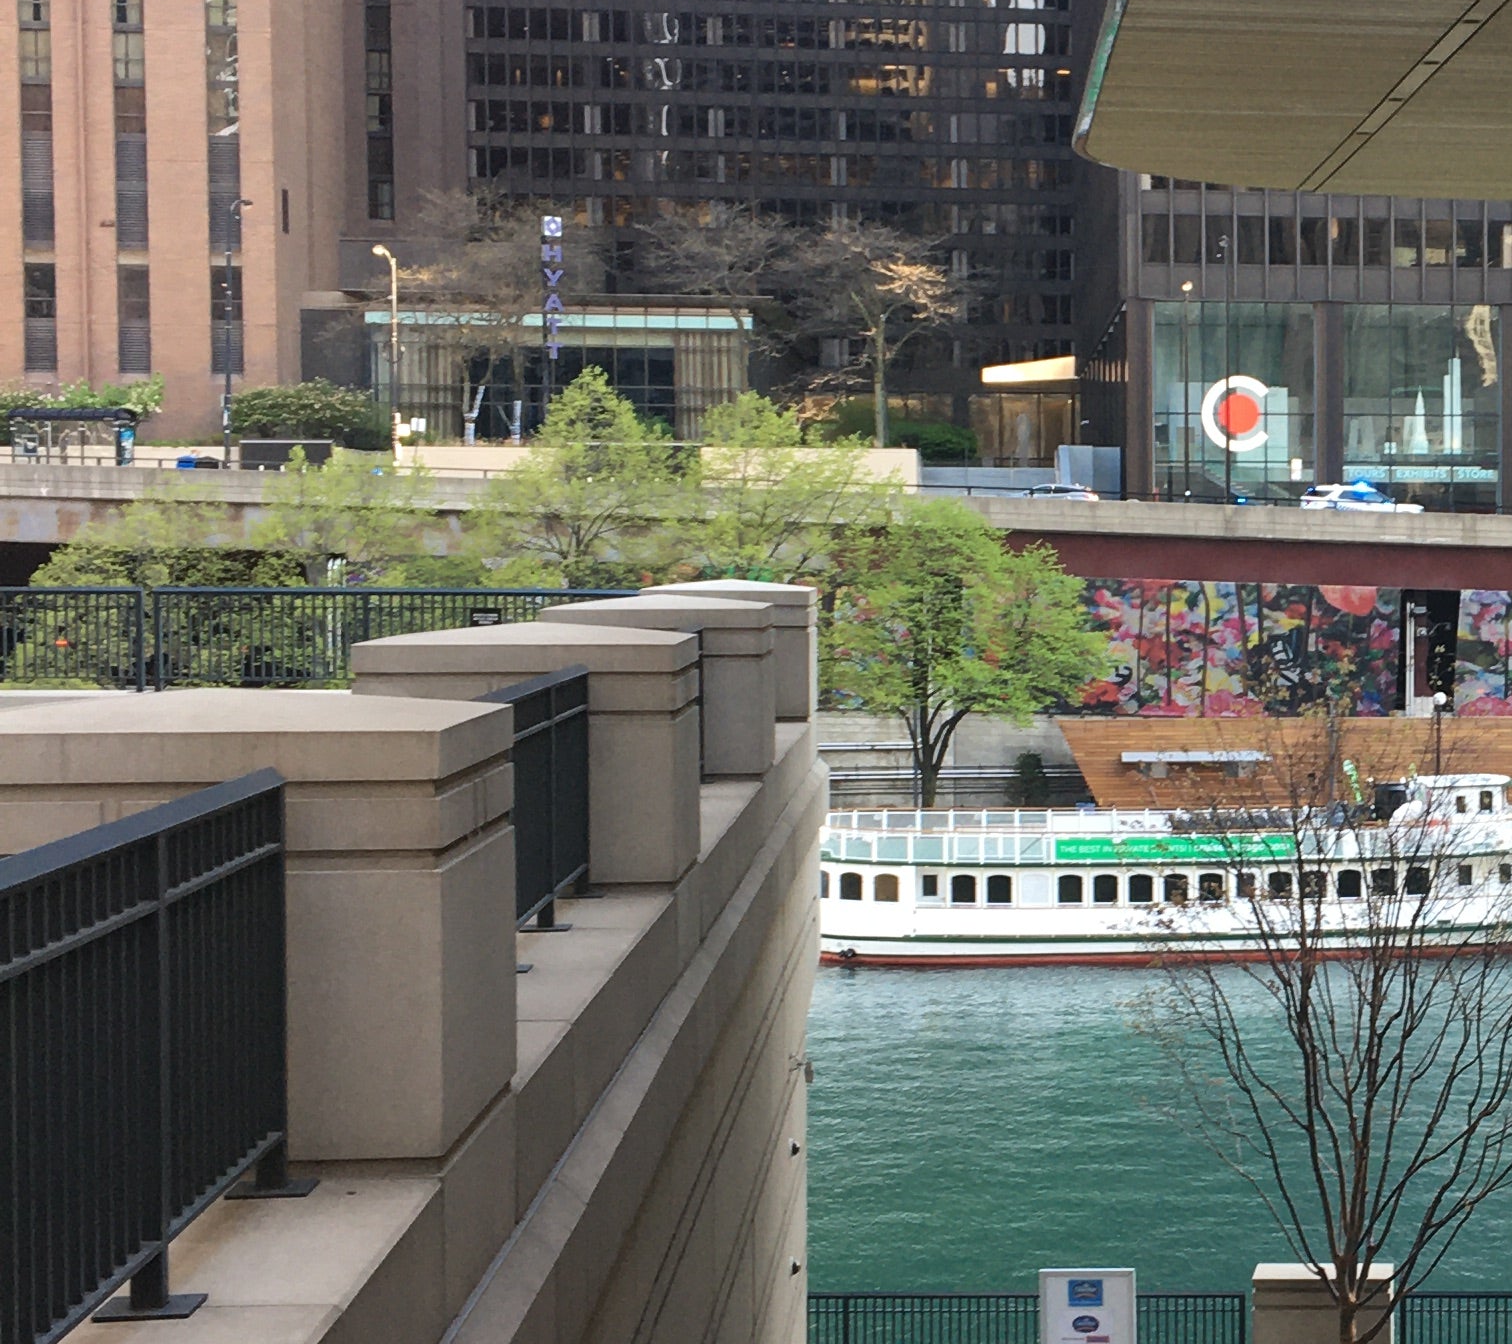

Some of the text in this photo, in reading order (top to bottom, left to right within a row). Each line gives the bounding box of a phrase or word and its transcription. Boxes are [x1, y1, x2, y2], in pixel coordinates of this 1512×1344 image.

[541, 243, 564, 360] HYATT
[1349, 469, 1494, 479] TOURS EXHIBITS STORE
[1060, 845, 1077, 853] THE
[1078, 845, 1101, 853] BEST
